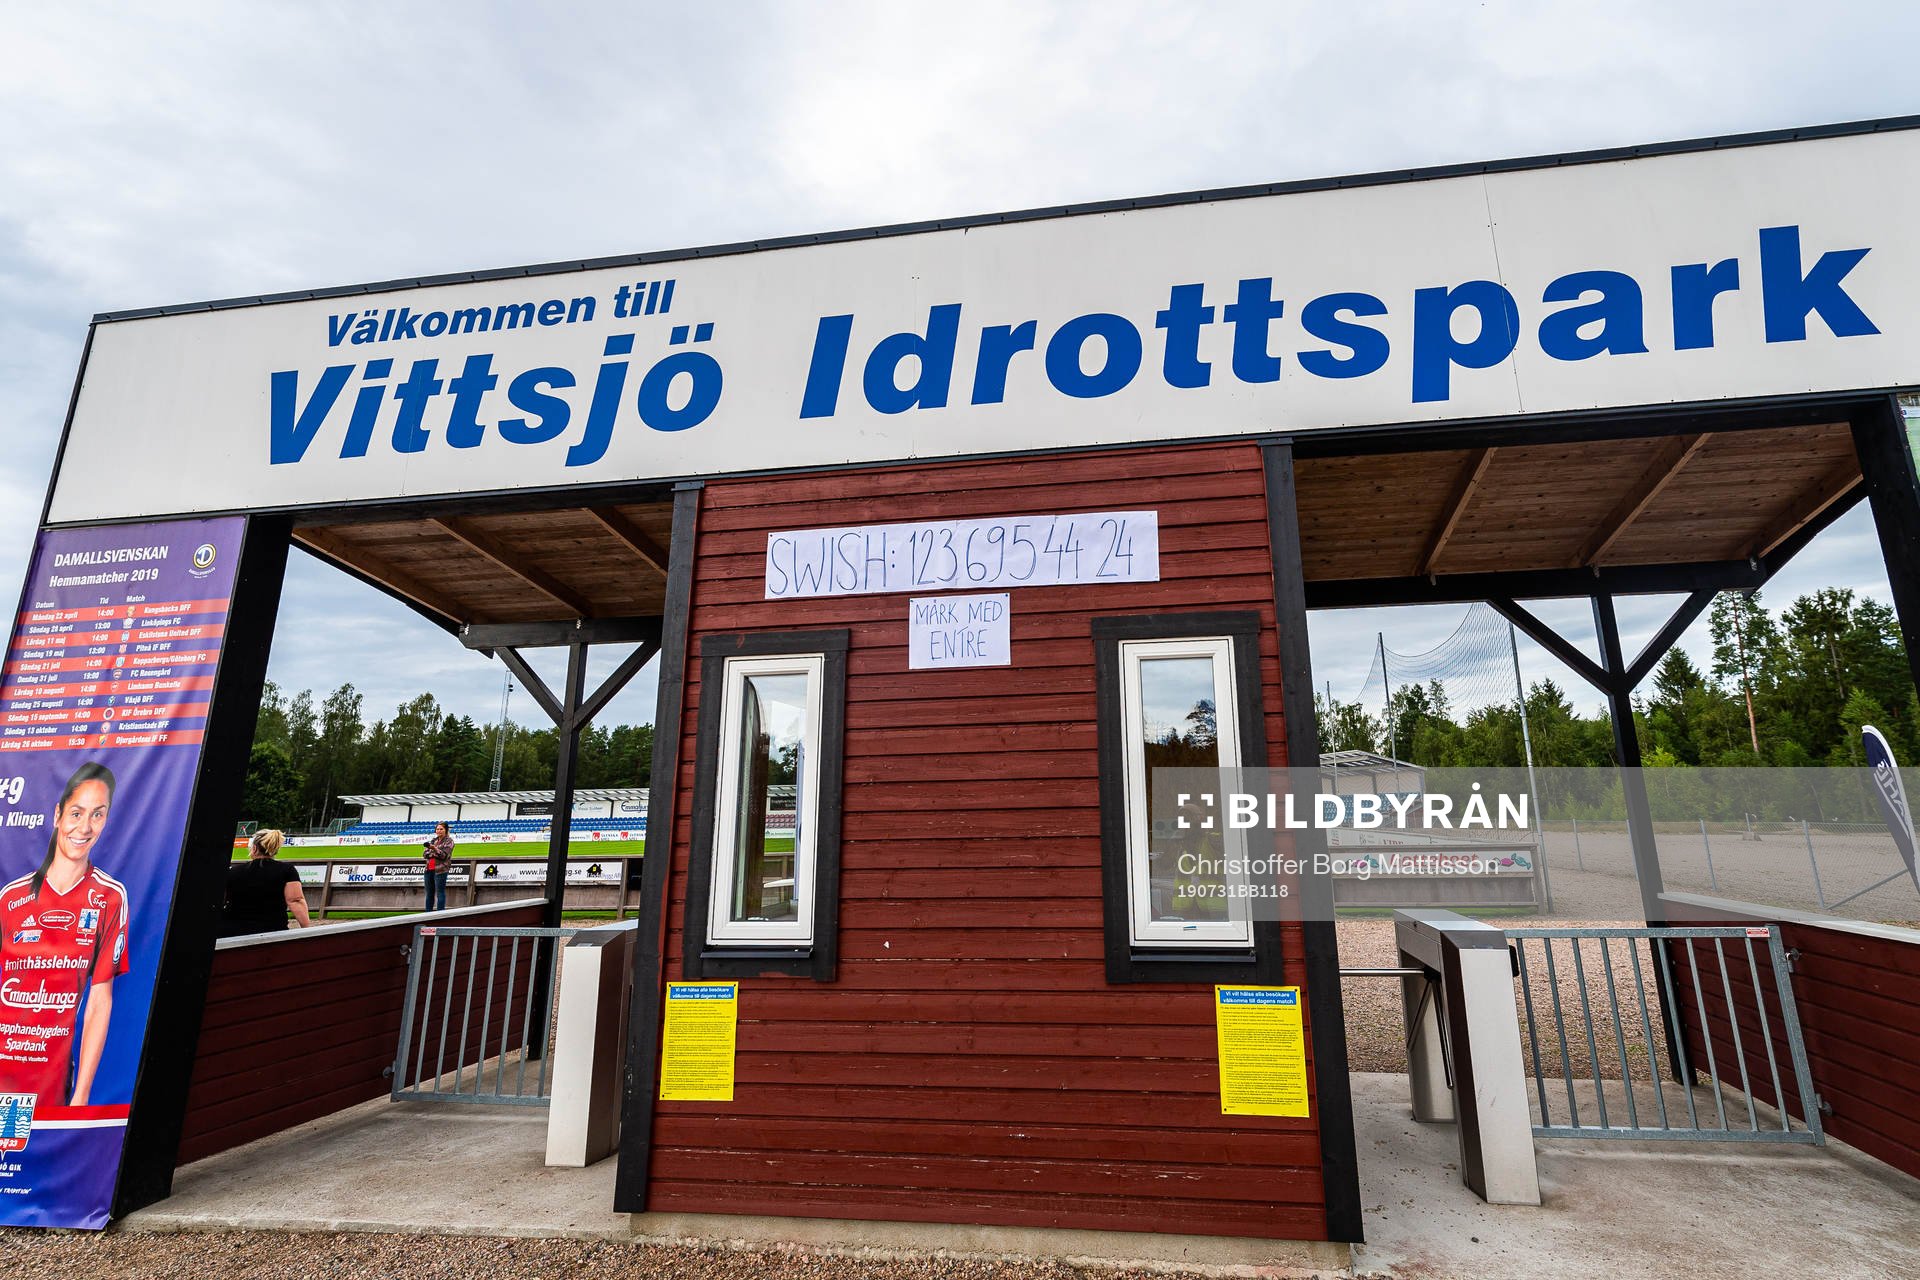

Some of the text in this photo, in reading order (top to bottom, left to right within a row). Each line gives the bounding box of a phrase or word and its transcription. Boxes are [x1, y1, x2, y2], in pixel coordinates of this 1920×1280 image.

[328, 279, 676, 348] Välkommen till
[270, 225, 1882, 467] Vittsjö Idrottspark
[54, 546, 169, 567] DAMALLSVENSKAN
[49, 568, 158, 588] Hemmamatcher 2019
[64, 612, 78, 620] april
[968, 600, 1002, 624] MED
[59, 624, 73, 633] april
[141, 619, 172, 627] Linköpings
[133, 708, 152, 716] Örebro
[6, 812, 44, 829] Klinga
[383, 866, 409, 876] Dagens
[5, 955, 89, 971] #mitthässleholm
[0, 978, 78, 1013] Emmaljunga
[0, 1023, 69, 1039] apphanebygdens
[5, 1038, 47, 1052] Sparbank
